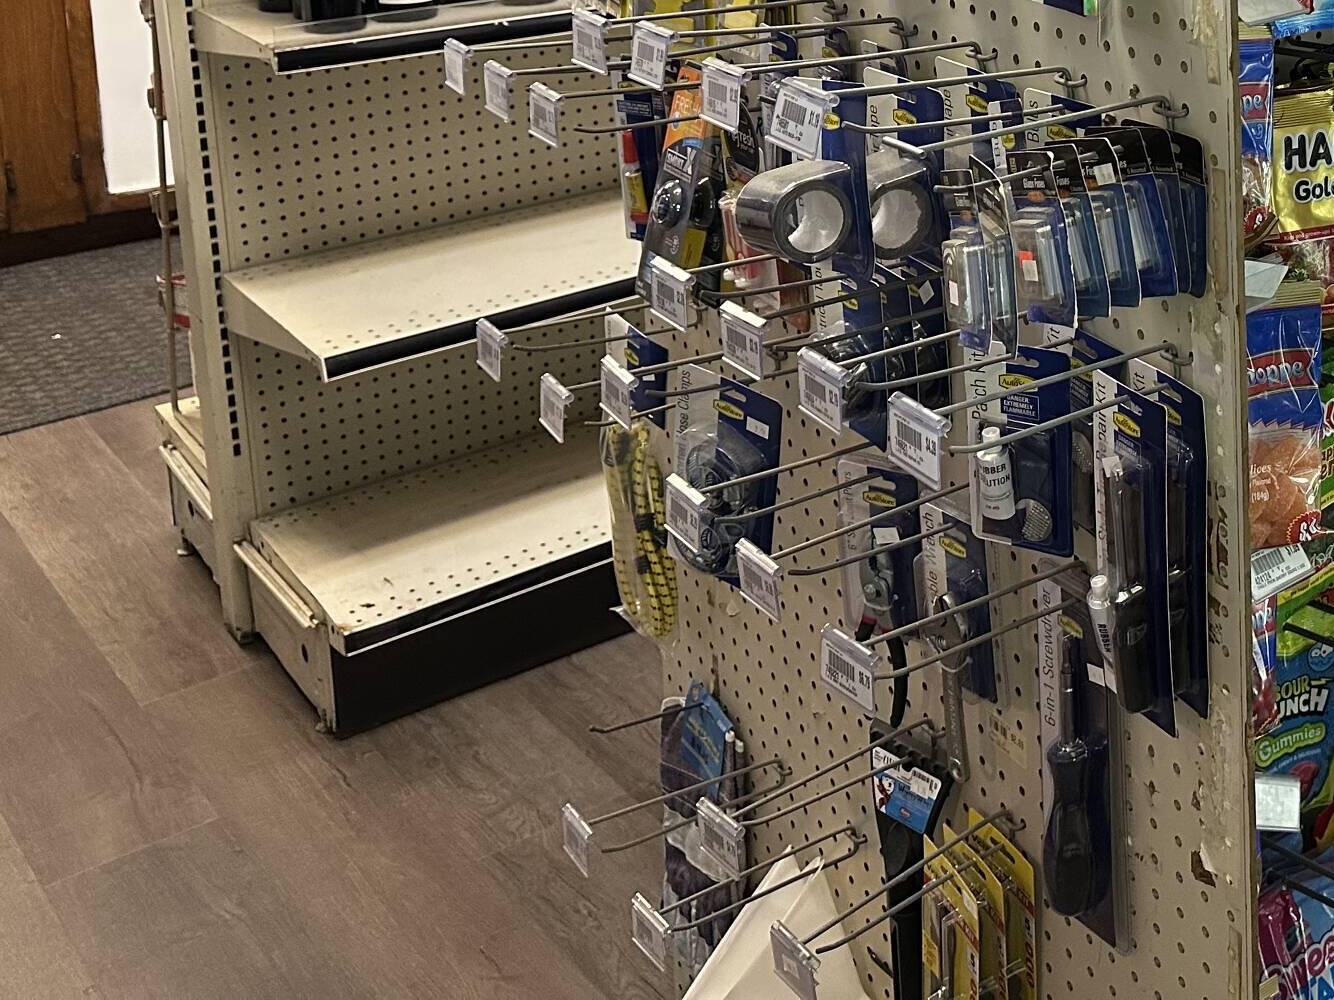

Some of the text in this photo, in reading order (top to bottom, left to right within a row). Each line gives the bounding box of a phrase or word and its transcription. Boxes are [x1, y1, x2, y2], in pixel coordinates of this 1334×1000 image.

[1040, 587, 1057, 728] 6-in-1 Screwdriver
[1257, 726, 1322, 761] Gummies
